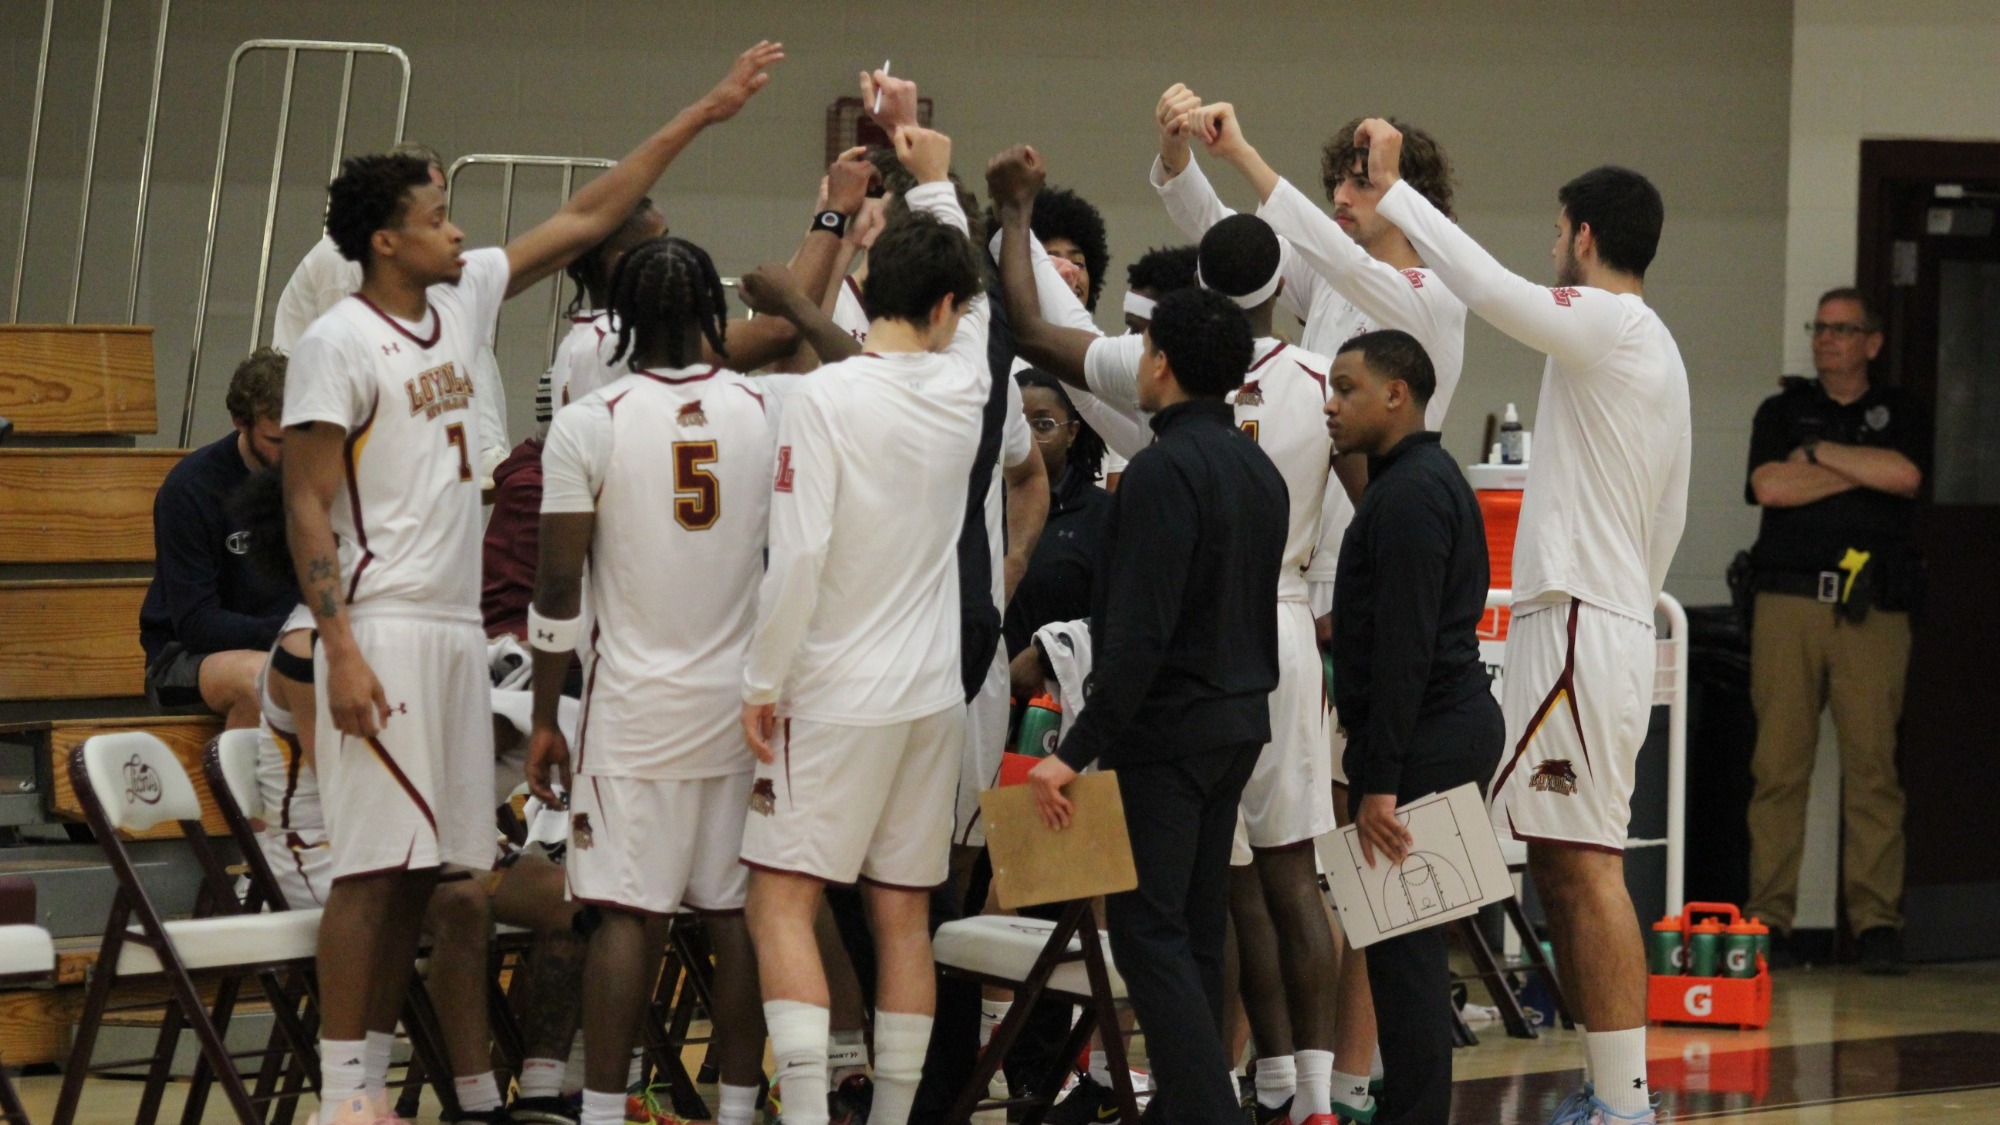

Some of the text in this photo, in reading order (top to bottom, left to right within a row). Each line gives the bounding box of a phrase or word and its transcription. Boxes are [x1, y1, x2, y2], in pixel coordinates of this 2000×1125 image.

[404, 361, 475, 417] LOYOLA
[671, 439, 720, 531] 5
[774, 446, 795, 493] L
[1727, 949, 1747, 971] G
[1683, 985, 1713, 1017] G
